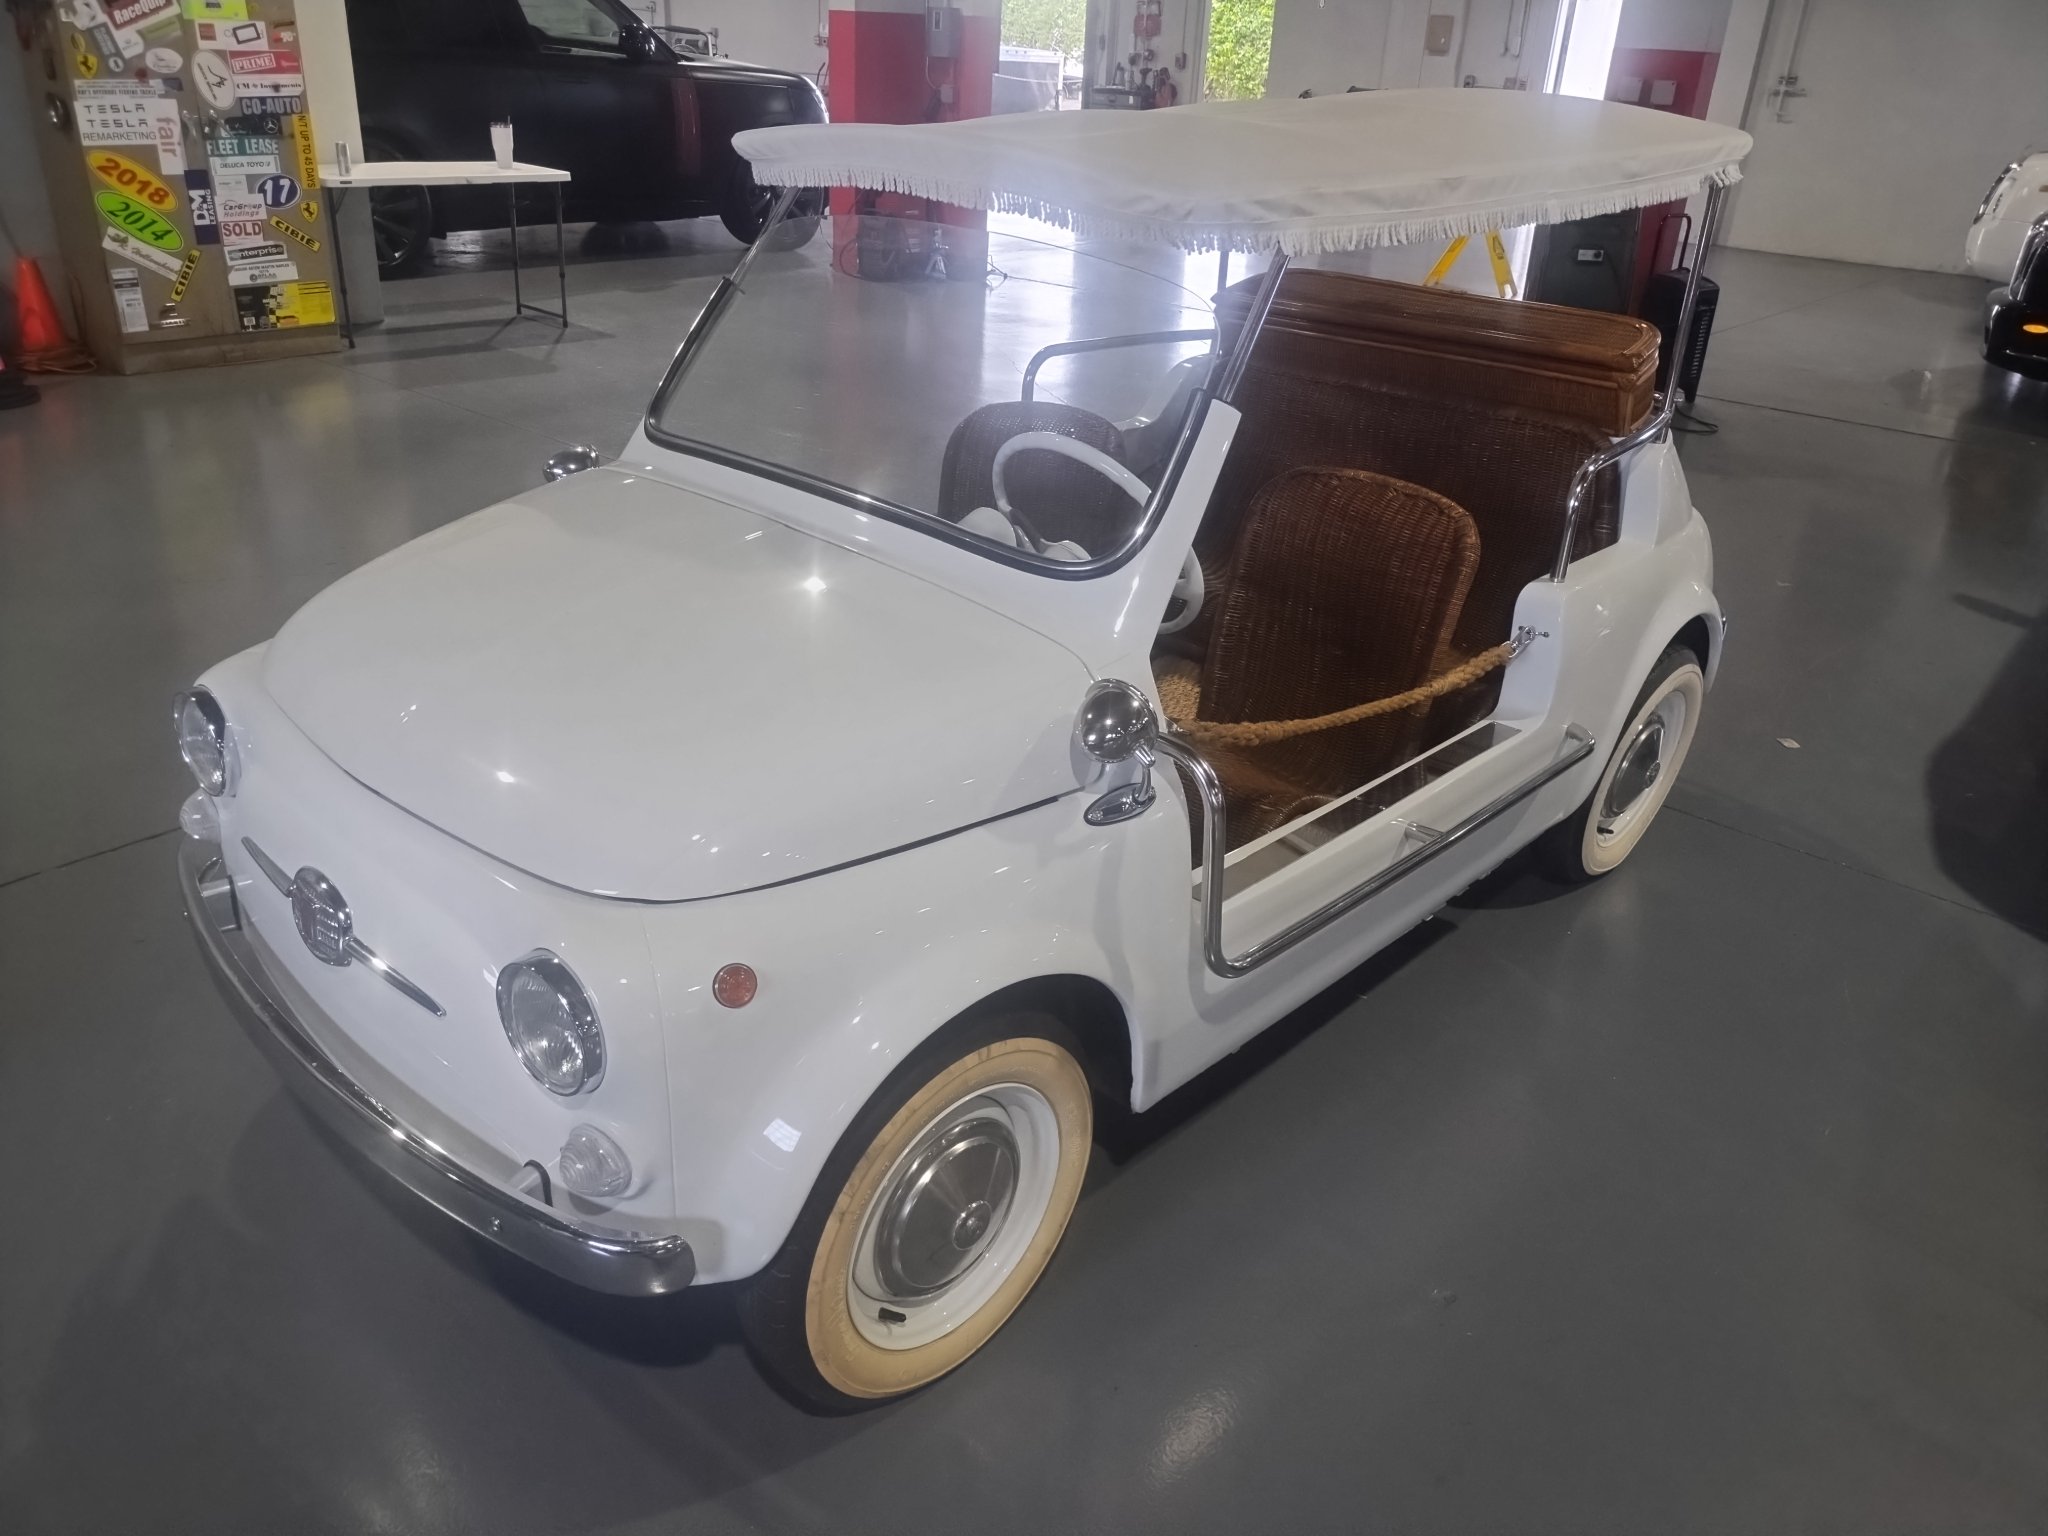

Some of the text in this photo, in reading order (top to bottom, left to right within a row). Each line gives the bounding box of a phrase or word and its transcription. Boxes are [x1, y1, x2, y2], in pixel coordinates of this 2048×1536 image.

[233, 55, 273, 71] PRIME
[83, 103, 146, 114] TESLA
[241, 97, 302, 115] CO-AUTO
[86, 118, 148, 128] TESLA
[82, 131, 157, 141] REMARKETING
[156, 117, 181, 157] fair
[300, 131, 310, 142] UP
[206, 138, 279, 155] FLEET LEASE
[302, 144, 311, 154] TO
[220, 161, 245, 169] DELUCA
[304, 156, 314, 166] 45
[96, 158, 170, 205] 2018
[305, 167, 316, 188] DAYS
[264, 178, 291, 205] 17
[204, 188, 217, 225] LEASING
[106, 201, 174, 241] 2014
[222, 222, 262, 237] SOLD
[275, 220, 317, 249] CIBIE
[174, 252, 198, 297] CIBIE
